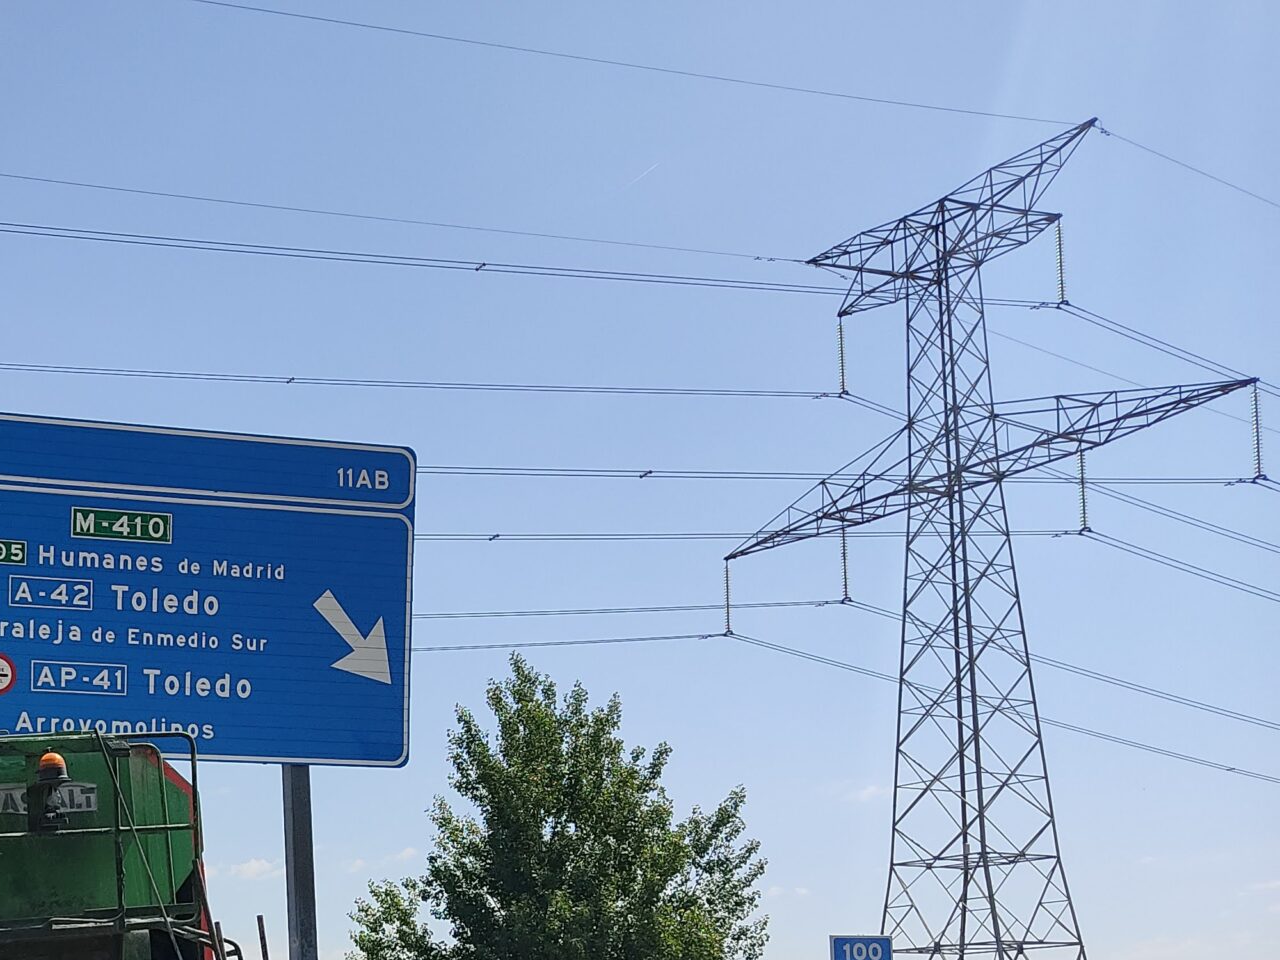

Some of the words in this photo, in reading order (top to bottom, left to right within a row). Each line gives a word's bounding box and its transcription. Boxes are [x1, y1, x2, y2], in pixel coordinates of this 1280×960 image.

[337, 467, 389, 490] 11AB
[75, 512, 165, 538] M-410
[38, 544, 163, 573] Humanes
[178, 558, 201, 575] de
[213, 559, 285, 580] Madrid
[14, 582, 89, 606] A-42
[111, 584, 219, 616] Toledo
[91, 626, 116, 643] de
[127, 628, 219, 649] Enmedio
[231, 633, 268, 651] Sur
[36, 665, 123, 690] AP-41
[143, 668, 252, 699] Toledo
[842, 942, 883, 960] 100
